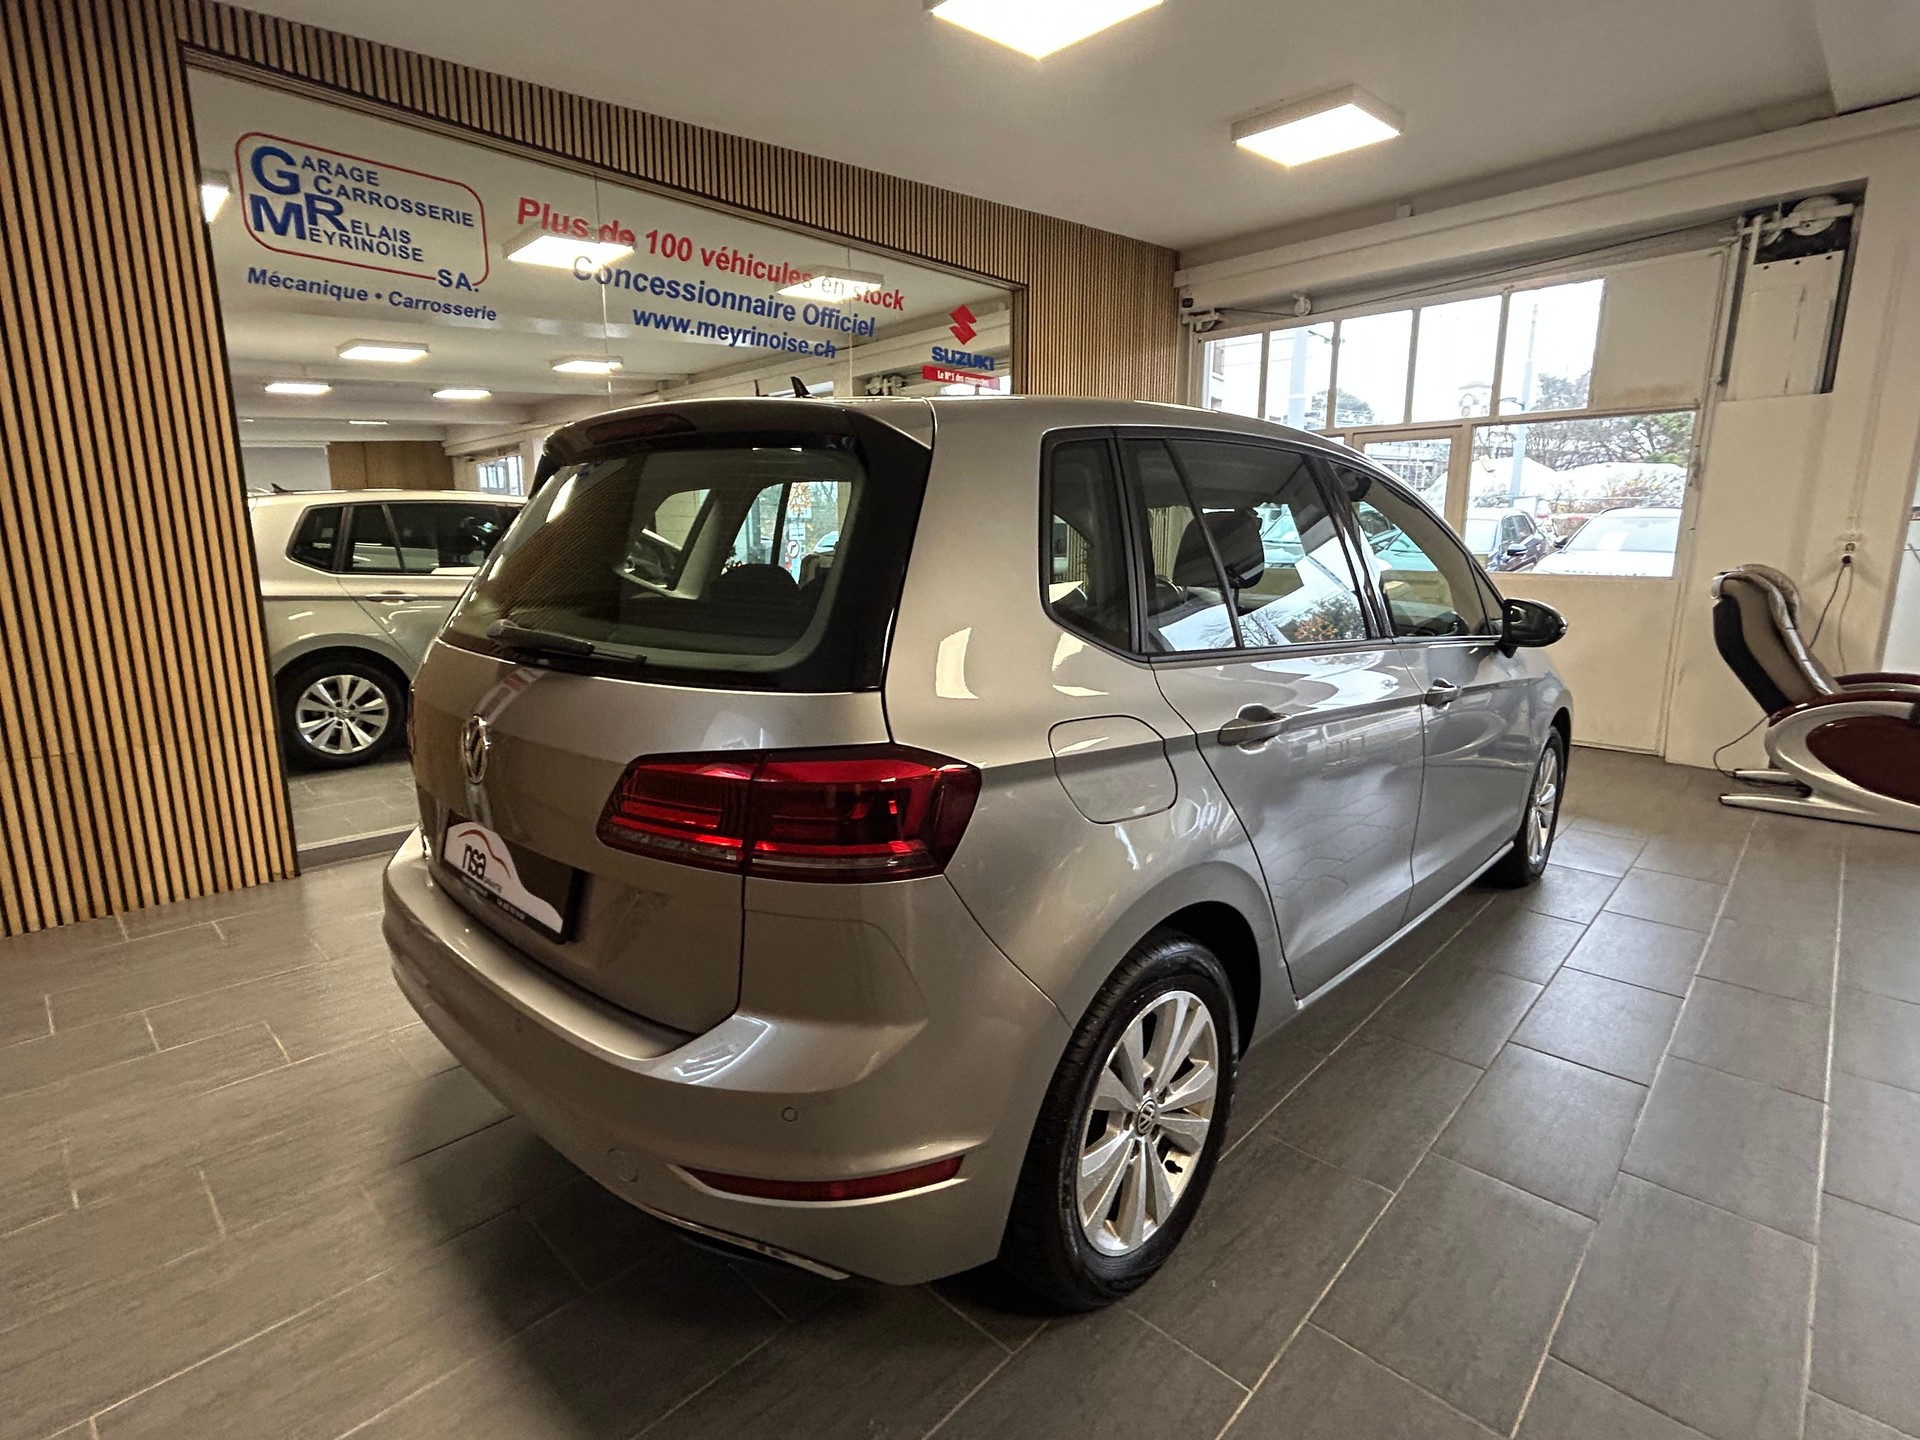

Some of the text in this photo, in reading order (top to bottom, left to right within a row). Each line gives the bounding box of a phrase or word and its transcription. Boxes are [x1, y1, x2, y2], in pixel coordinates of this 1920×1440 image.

[251, 145, 380, 195] GARAGE
[249, 193, 425, 262] MEYRINOISE
[304, 192, 412, 245] RELAIS
[313, 175, 475, 227] CARROSSERIE
[517, 196, 905, 312] Plus de 100 véhicules en stock
[247, 267, 497, 321] Mécanique Carrosserie
[572, 255, 876, 339] Concessionnaire Officiel
[632, 308, 837, 360] www.meyrinoise.ch
[931, 346, 996, 372] SUZUKI
